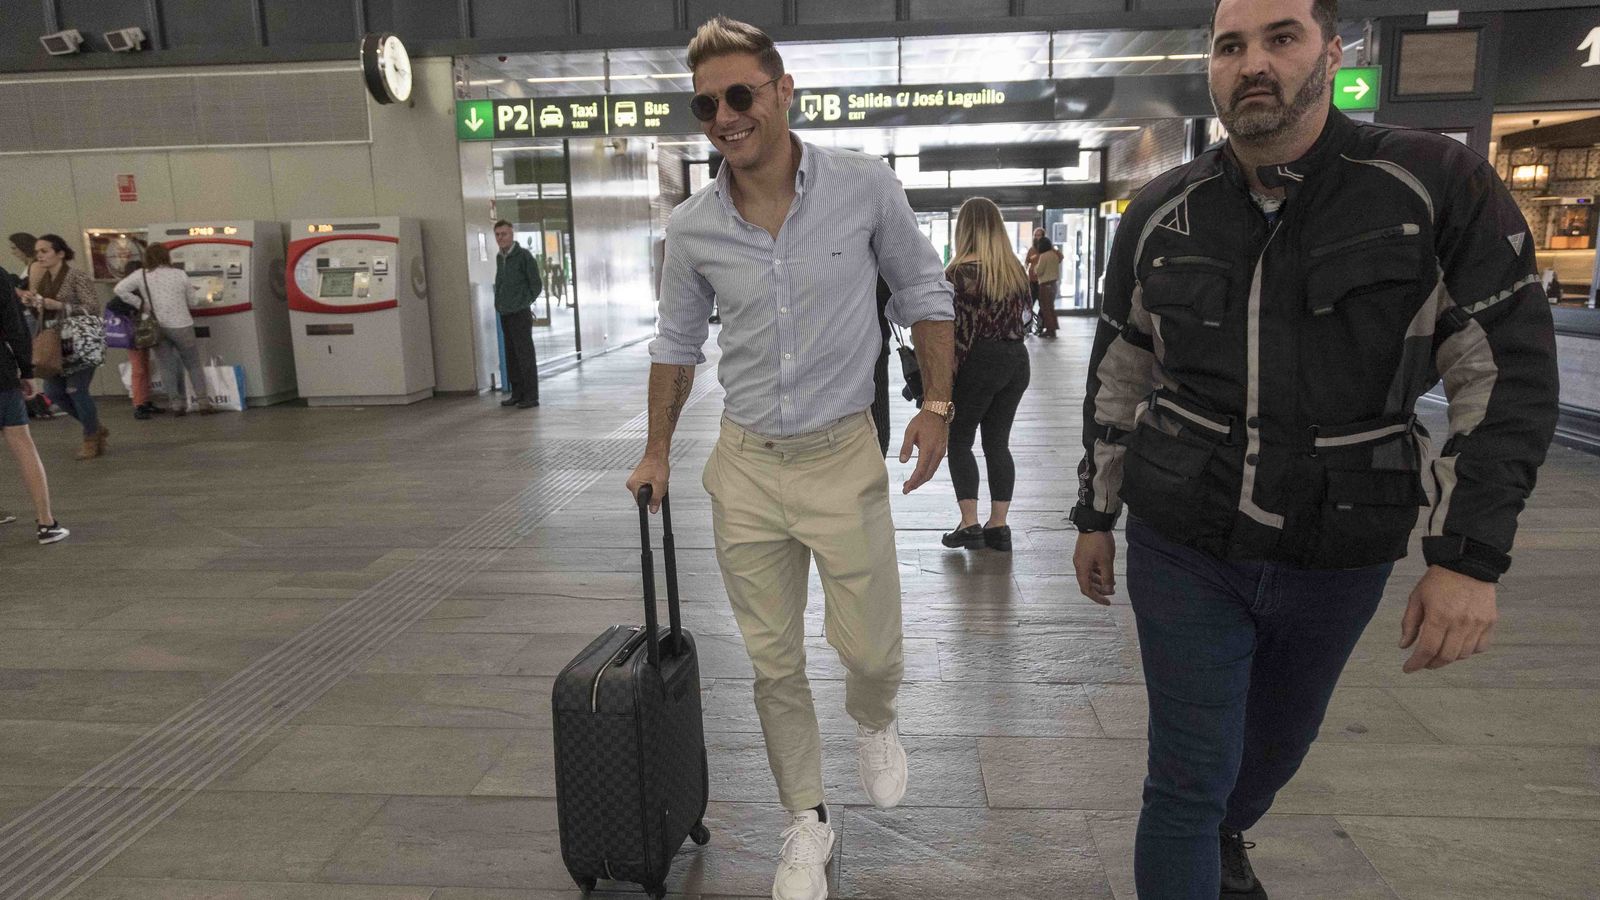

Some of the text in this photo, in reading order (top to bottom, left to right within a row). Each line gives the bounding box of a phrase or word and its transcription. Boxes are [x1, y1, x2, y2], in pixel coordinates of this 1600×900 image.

[848, 89, 1005, 108] Salida C/ José Laguillo
[570, 102, 598, 118] Taxi
[644, 102, 670, 116] Bus
[823, 94, 842, 121] B
[497, 105, 529, 131] P2
[644, 118, 660, 127] BUS
[848, 111, 866, 120] EXIT
[571, 121, 588, 129] TAXI
